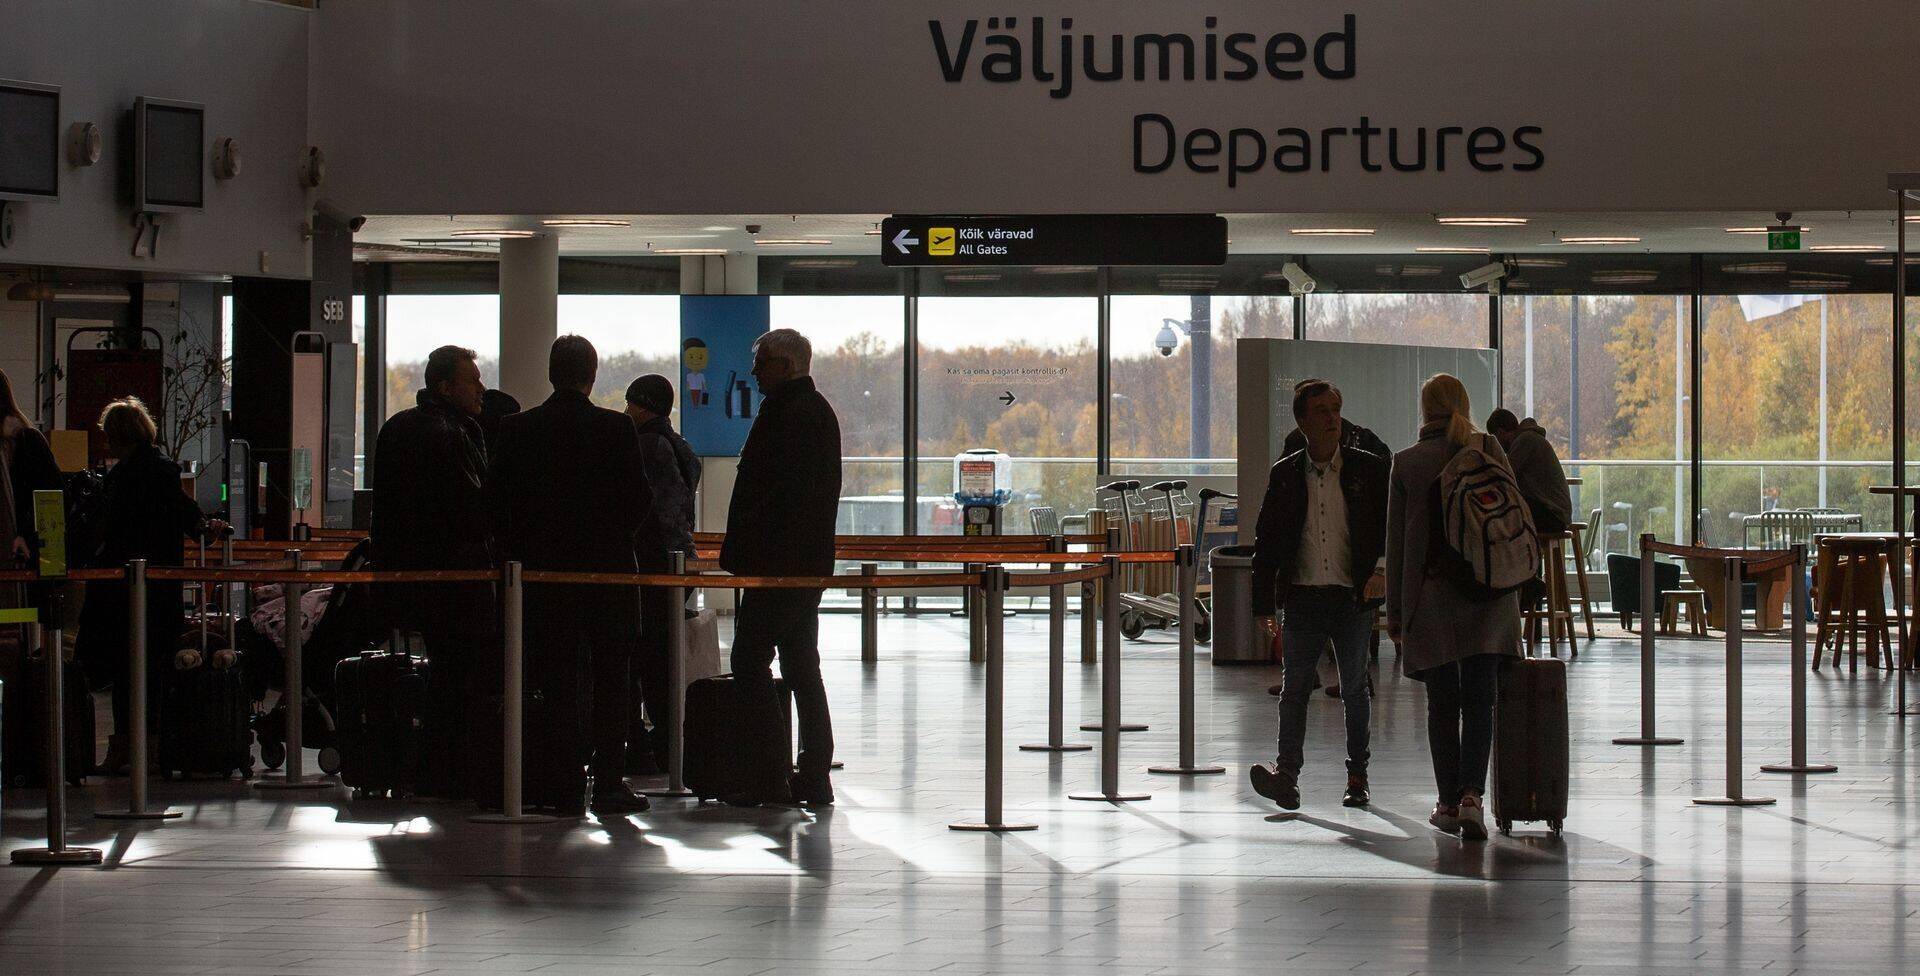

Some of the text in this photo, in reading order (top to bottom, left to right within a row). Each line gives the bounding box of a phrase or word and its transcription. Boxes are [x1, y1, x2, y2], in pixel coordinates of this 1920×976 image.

[928, 14, 1356, 99] Väljumised
[1133, 113, 1545, 189] Departures
[959, 228, 1034, 239] Kõik väravad
[959, 244, 1008, 255] All Gates
[323, 300, 344, 320] SEB
[992, 368, 1019, 377] pagasit
